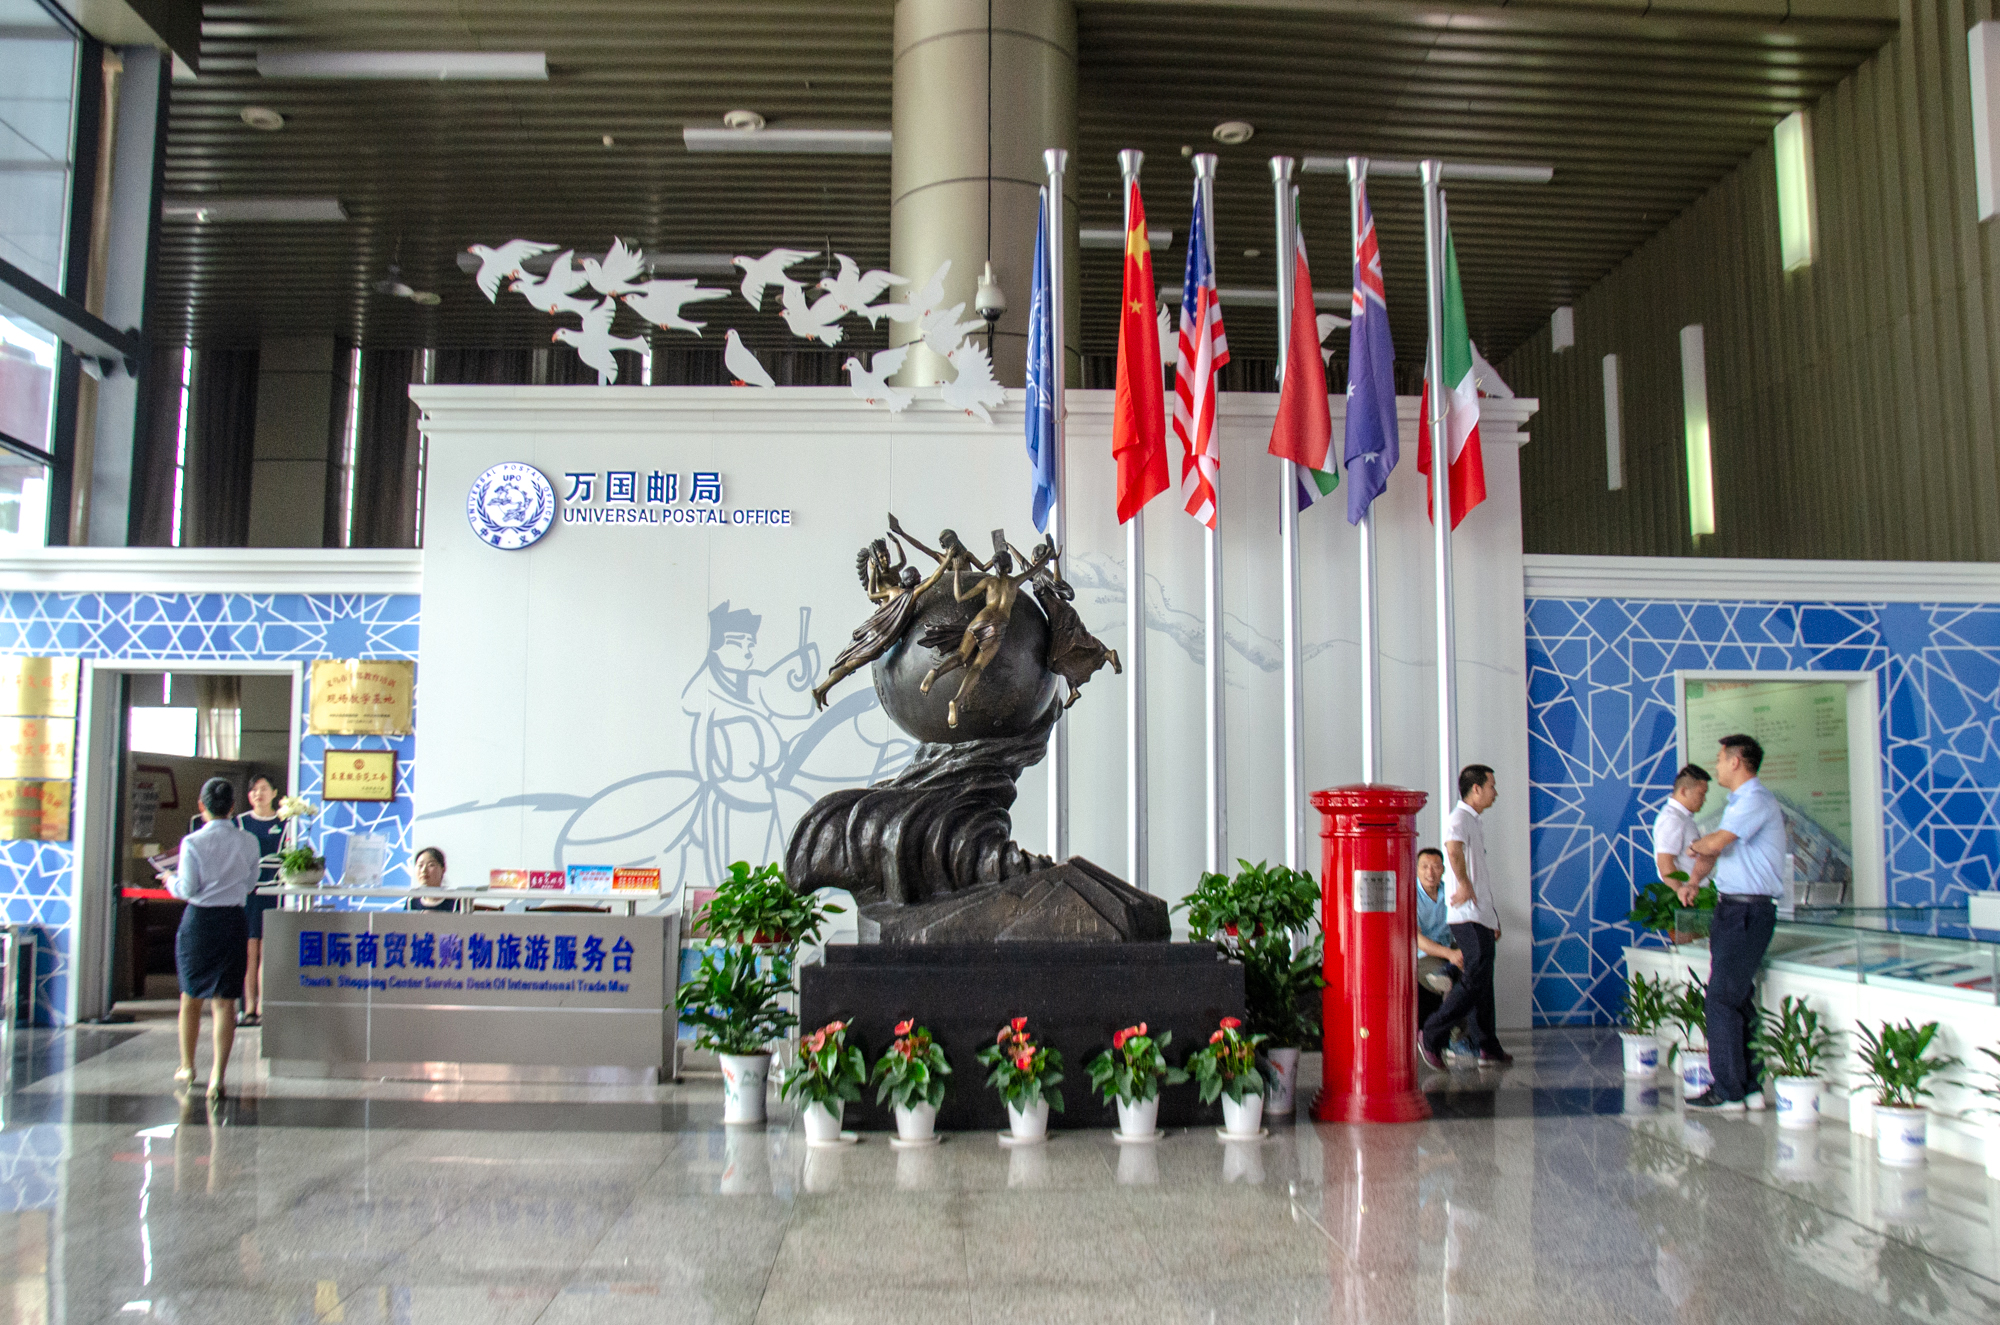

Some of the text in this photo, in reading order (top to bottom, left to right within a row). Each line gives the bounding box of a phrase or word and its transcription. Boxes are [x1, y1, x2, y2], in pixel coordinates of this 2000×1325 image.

[502, 474, 522, 482] UPO
[564, 470, 722, 504] 万国邮局
[503, 464, 542, 481] POSTAL
[542, 486, 554, 523] OFFICE
[563, 508, 791, 524] UNIVERSAL POSTAL OFFICE
[299, 931, 635, 973] 国际商贸城购物旅游服务台
[337, 974, 387, 991] Shopping
[388, 975, 423, 989] Center
[424, 976, 463, 990] Service
[466, 977, 492, 991] Desk
[493, 977, 507, 991] Of
[507, 978, 575, 992] International
[577, 979, 607, 993] Trade
